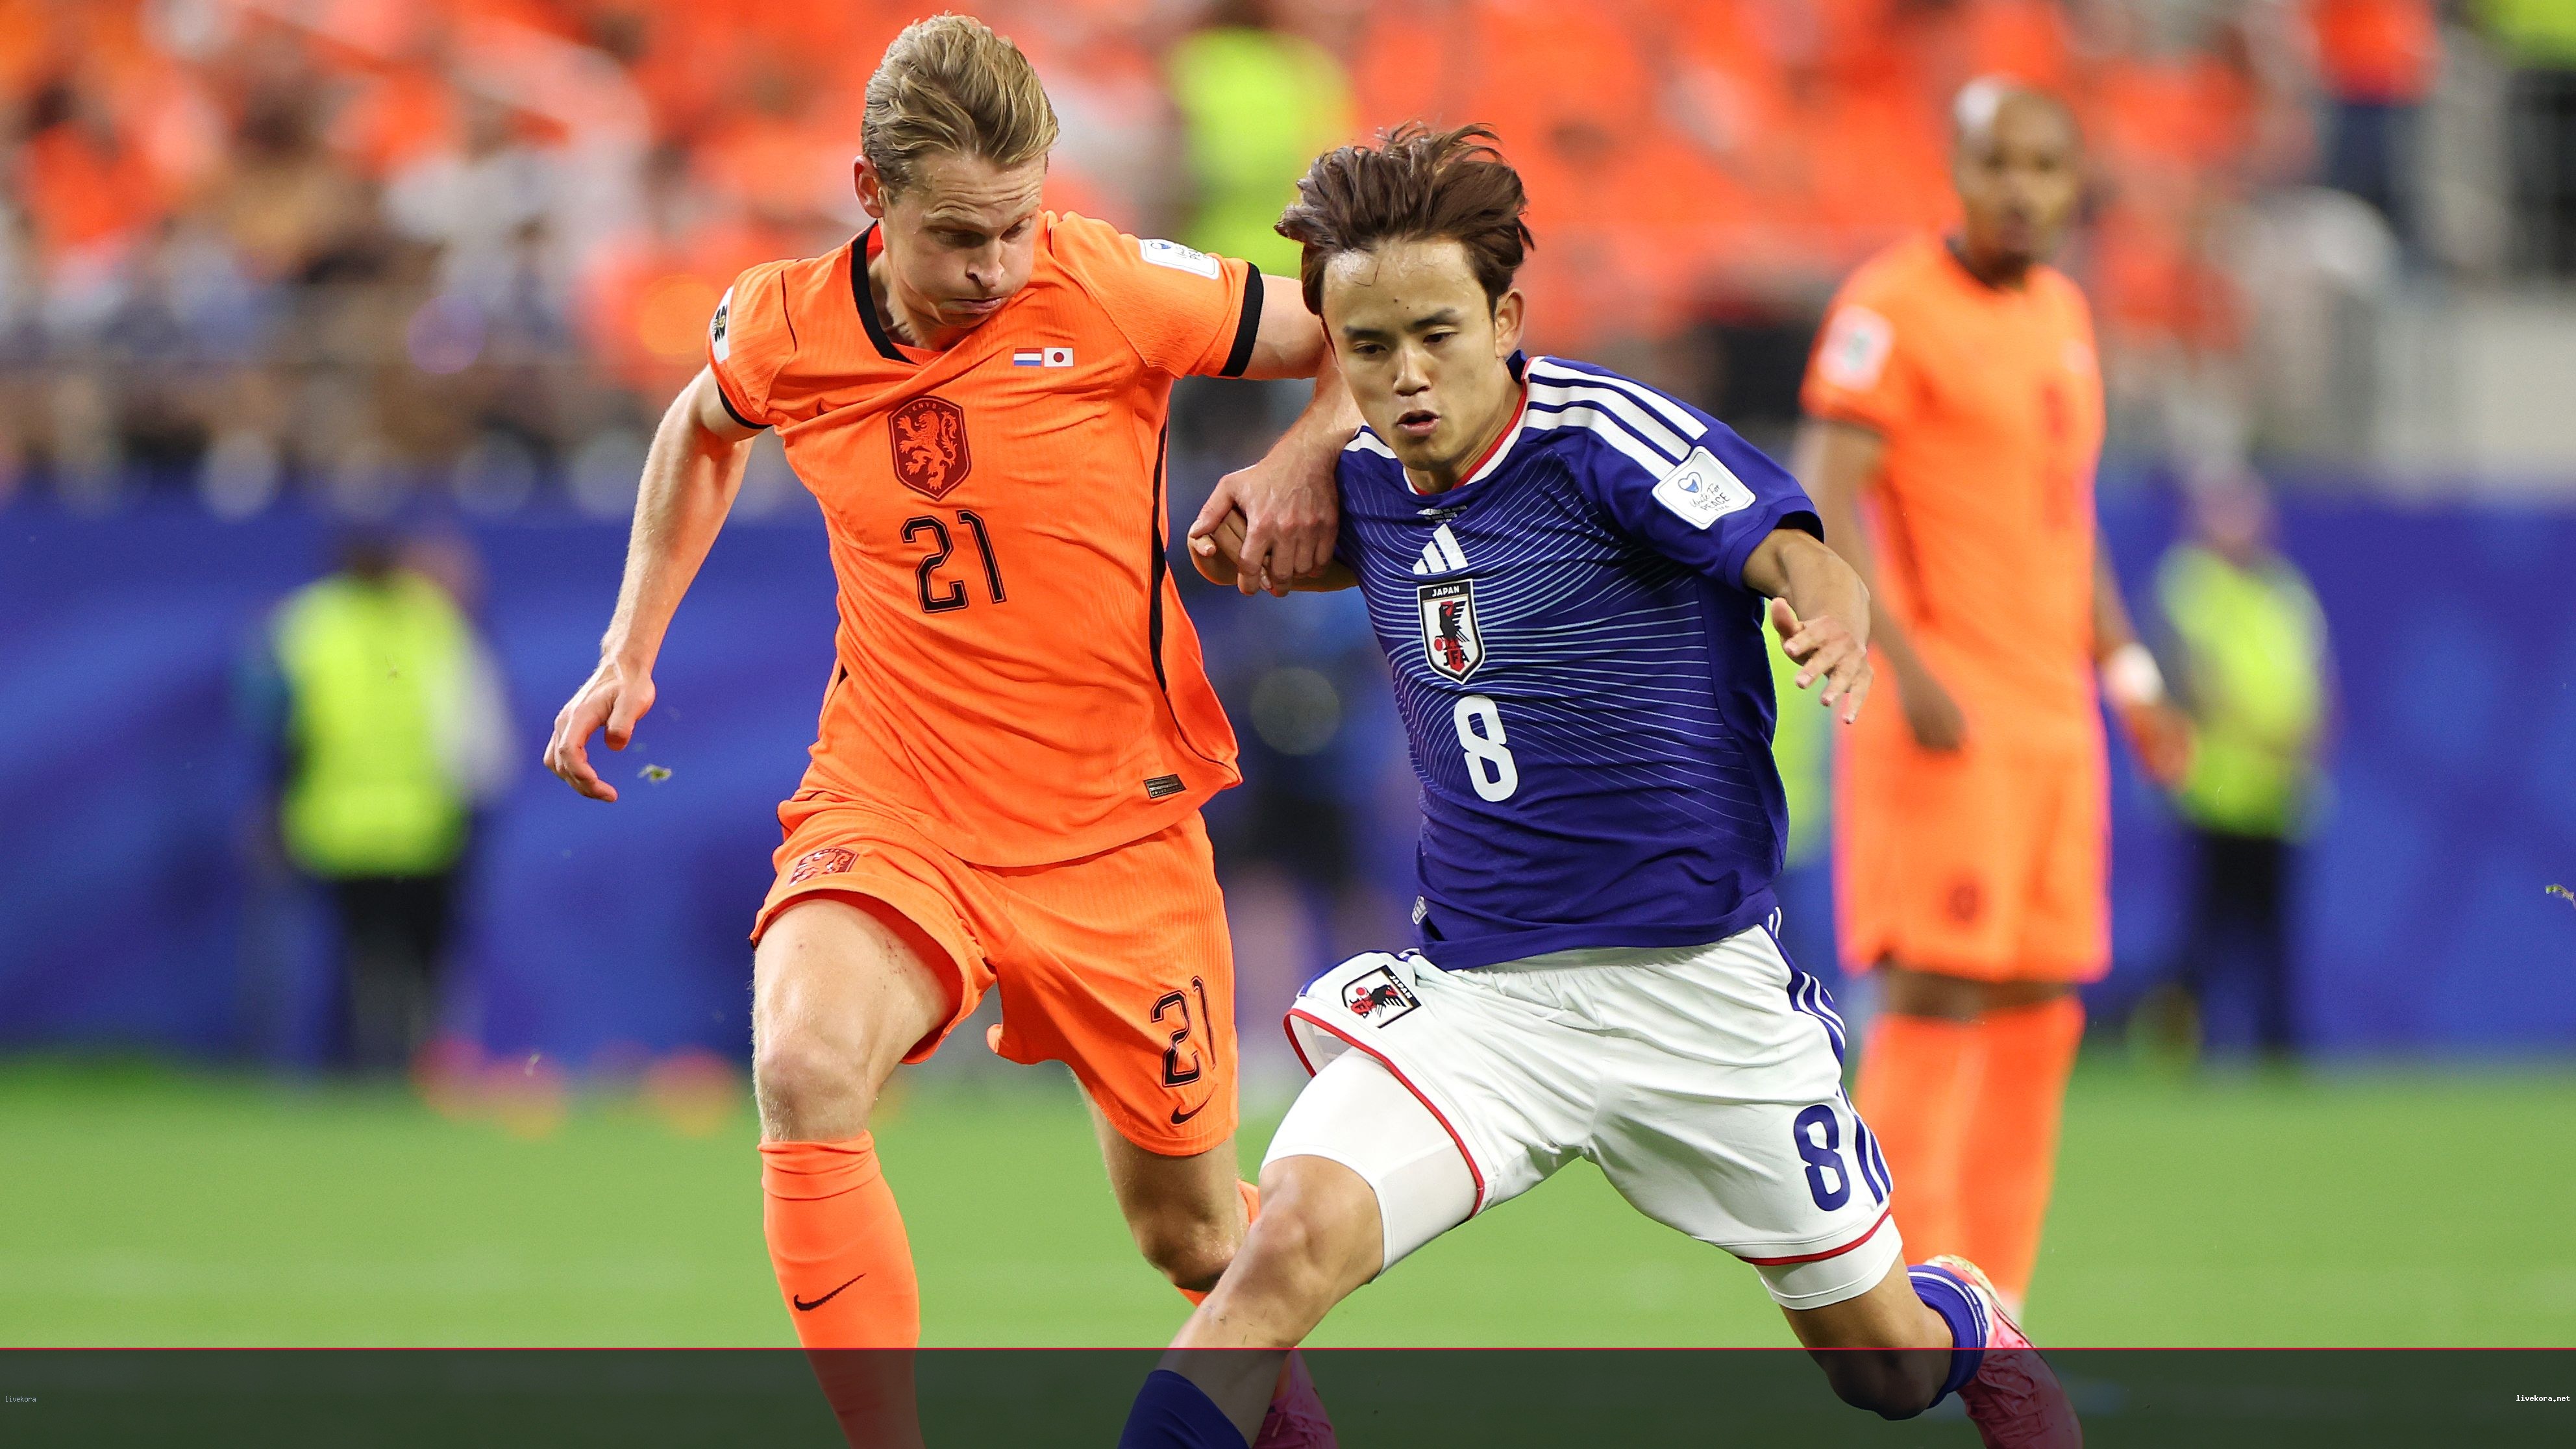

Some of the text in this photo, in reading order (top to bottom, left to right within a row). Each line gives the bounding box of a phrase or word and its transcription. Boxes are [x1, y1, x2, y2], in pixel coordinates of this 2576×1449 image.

[1700, 492, 1731, 511] PEACE
[900, 509, 1007, 613] 21
[1432, 585, 1460, 597] JAPAN
[1443, 649, 1470, 666] JFA
[1454, 694, 1518, 802] 8
[1389, 975, 1413, 999] JAPAN
[1150, 976, 1217, 1087] 21
[1794, 1104, 1850, 1211] 8
